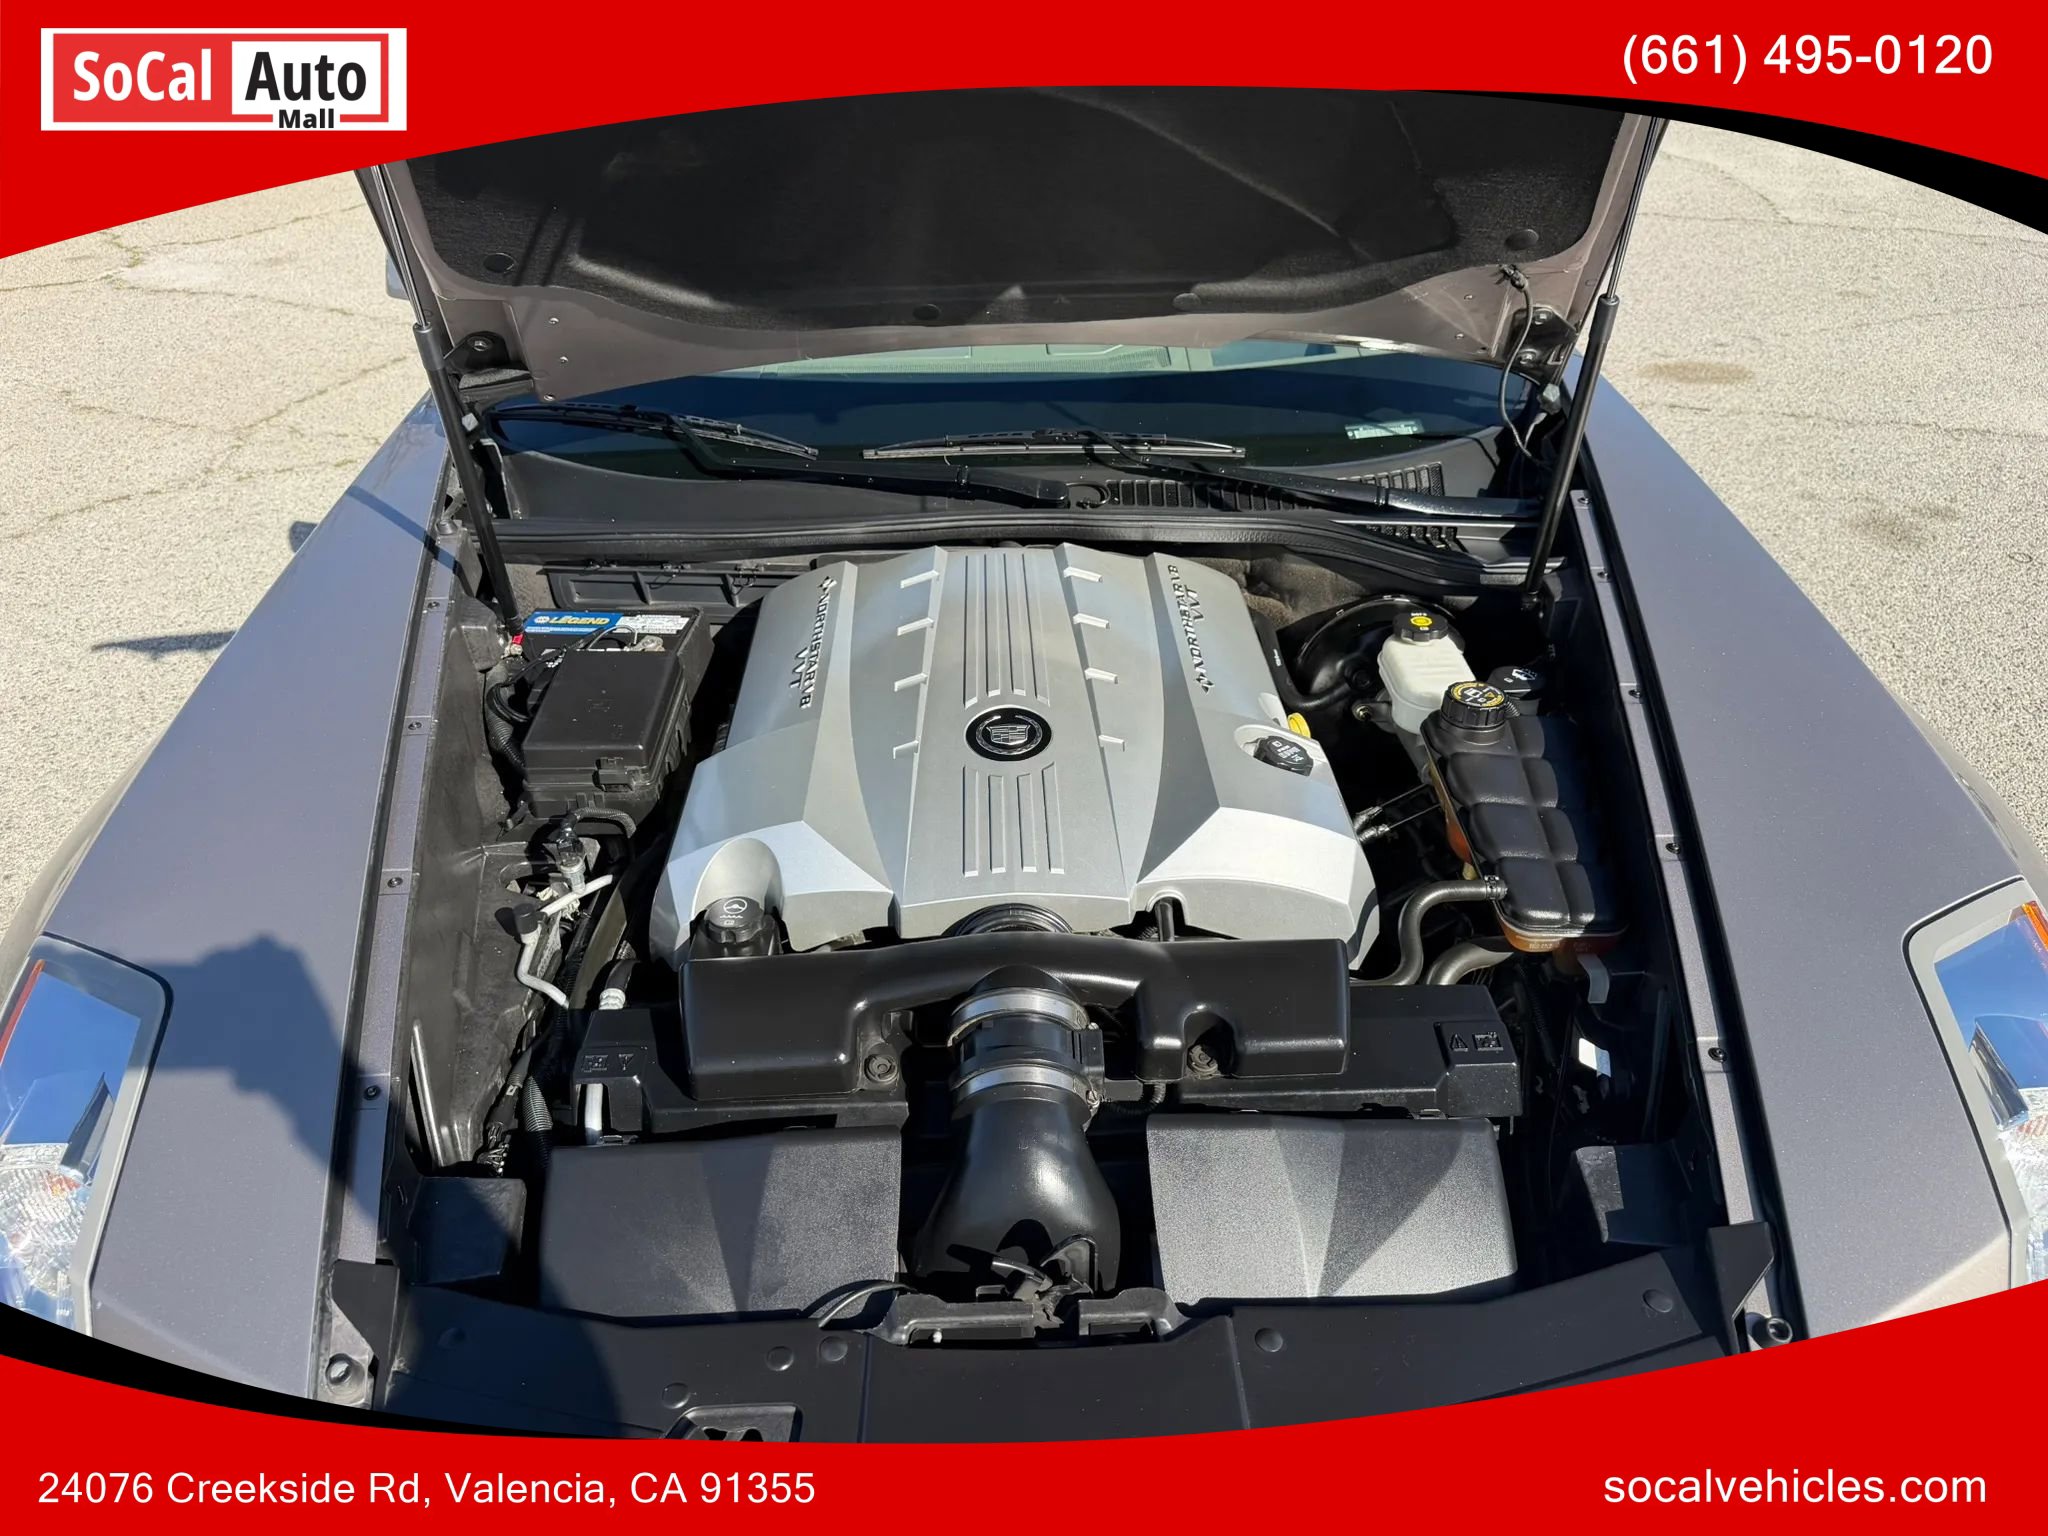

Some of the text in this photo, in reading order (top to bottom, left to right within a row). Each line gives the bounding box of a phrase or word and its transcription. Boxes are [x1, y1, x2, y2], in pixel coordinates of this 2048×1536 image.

[549, 615, 611, 626] LEGEND
[803, 593, 830, 685] NORTHSTAR
[789, 647, 809, 689] VVT
